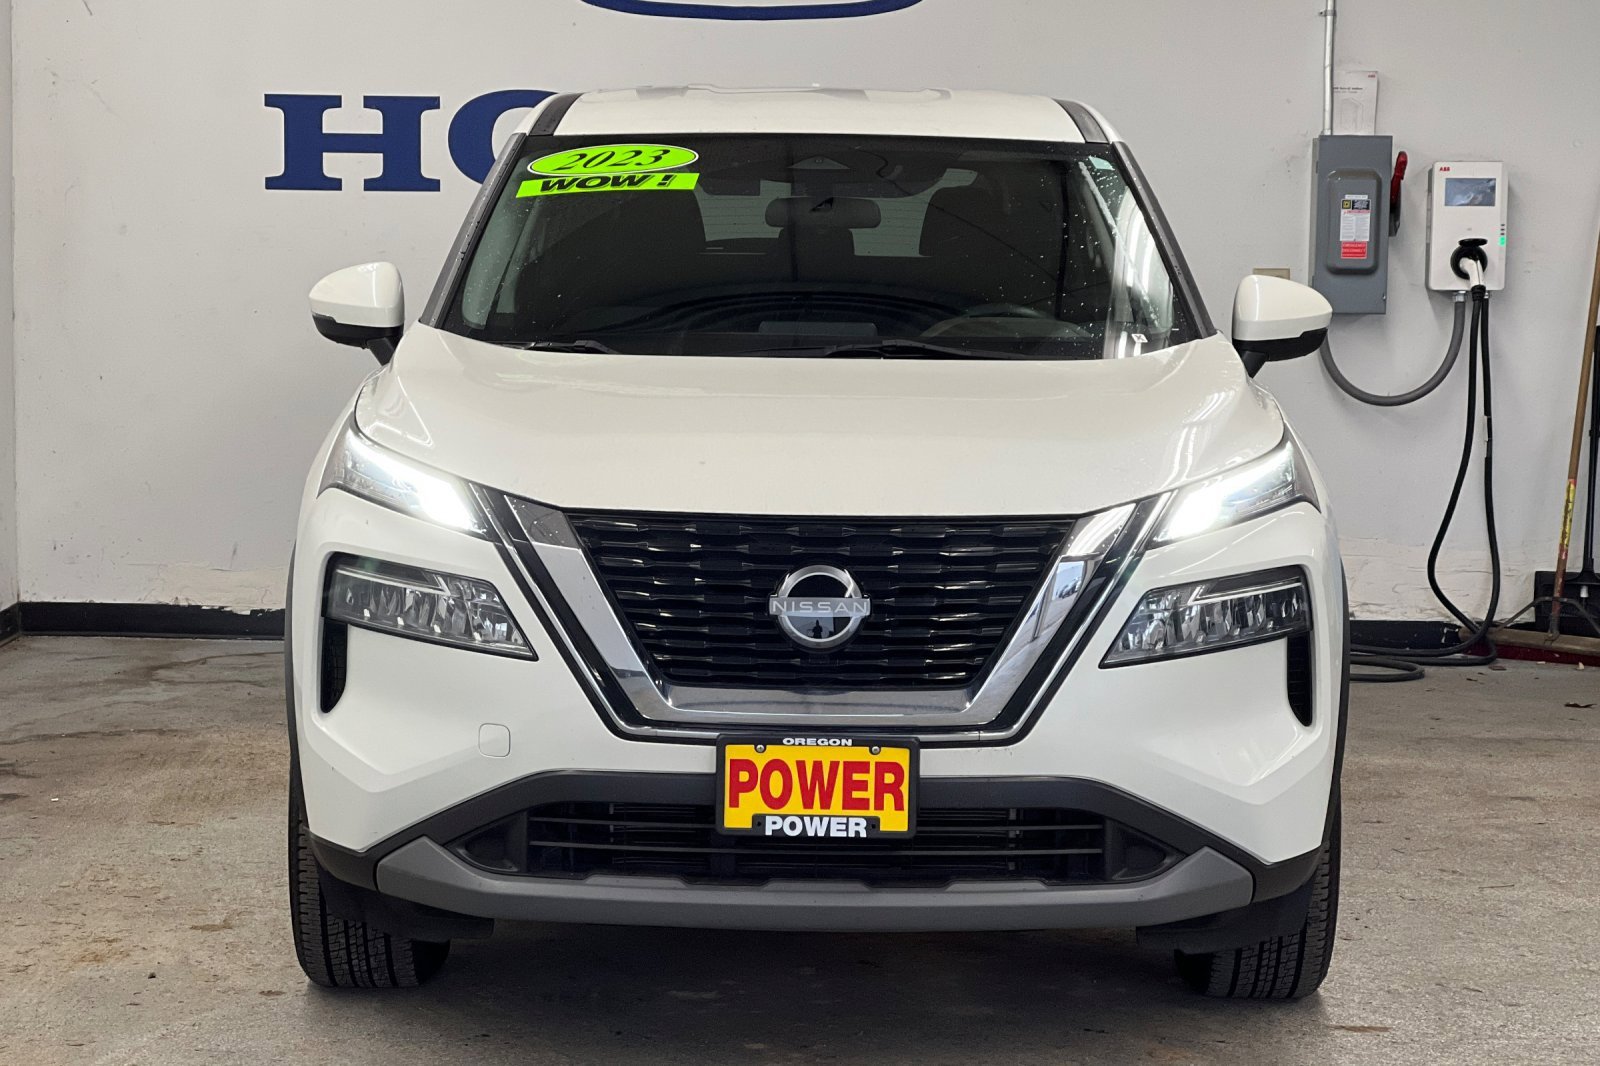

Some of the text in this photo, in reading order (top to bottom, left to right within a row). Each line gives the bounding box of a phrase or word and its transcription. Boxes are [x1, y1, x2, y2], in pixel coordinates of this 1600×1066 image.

[551, 148, 671, 172] 2023
[772, 600, 867, 613] NISSAN
[782, 737, 853, 747] OREGON
[728, 758, 905, 812] POWER
[764, 815, 867, 838] POWER
